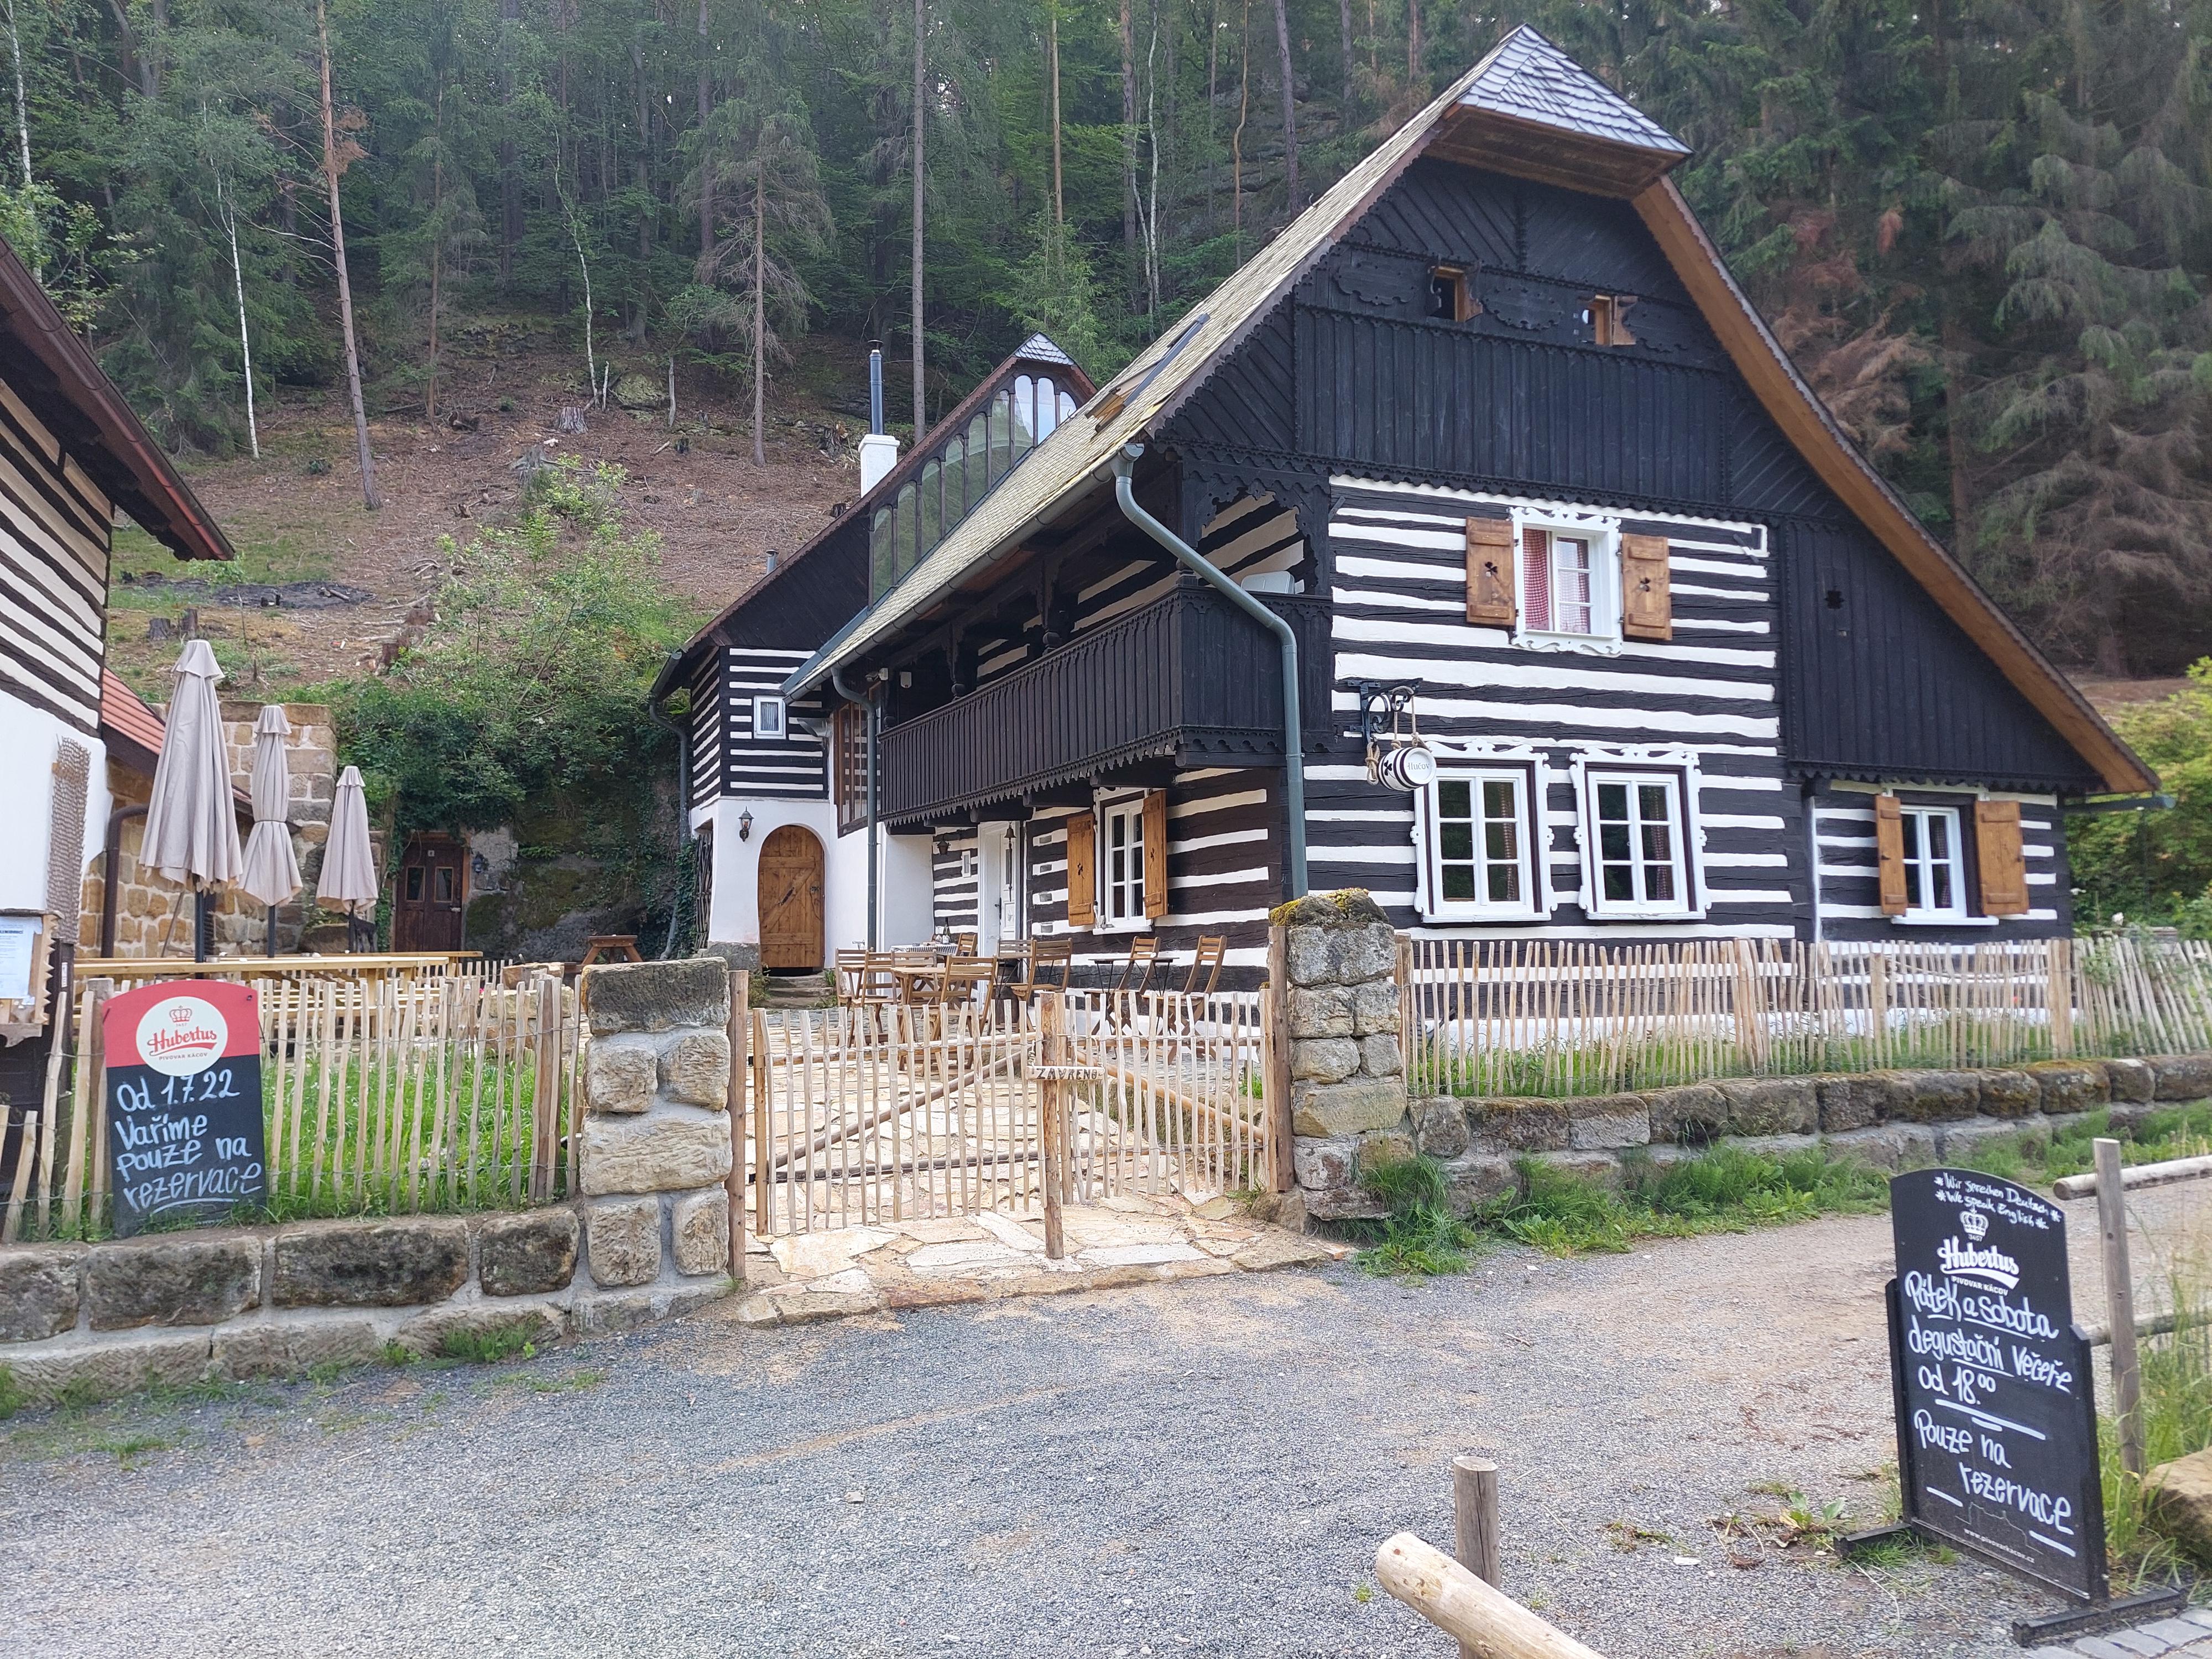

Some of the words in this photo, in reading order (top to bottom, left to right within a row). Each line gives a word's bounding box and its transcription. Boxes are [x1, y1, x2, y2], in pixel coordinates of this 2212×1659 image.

[147, 1026, 217, 1053] Hubertus
[117, 1076, 155, 1112] Od
[115, 1113, 207, 1150] Vaříme
[216, 1138, 252, 1160] na
[123, 1162, 263, 1213] rezervace
[1943, 1172, 1963, 1190] Wir
[1945, 1191, 1964, 1203] We
[1937, 1235, 2019, 1275] Hubertus
[1905, 1271, 1961, 1322] Pátek
[1963, 1297, 1979, 1317] a
[1951, 1275, 1983, 1290] PIVOVAR
[1983, 1284, 2008, 1296] KÁCOV
[1914, 1409, 1973, 1454] Pouze
[1981, 1434, 2012, 1469] na
[1959, 1462, 2074, 1535] rezervace
